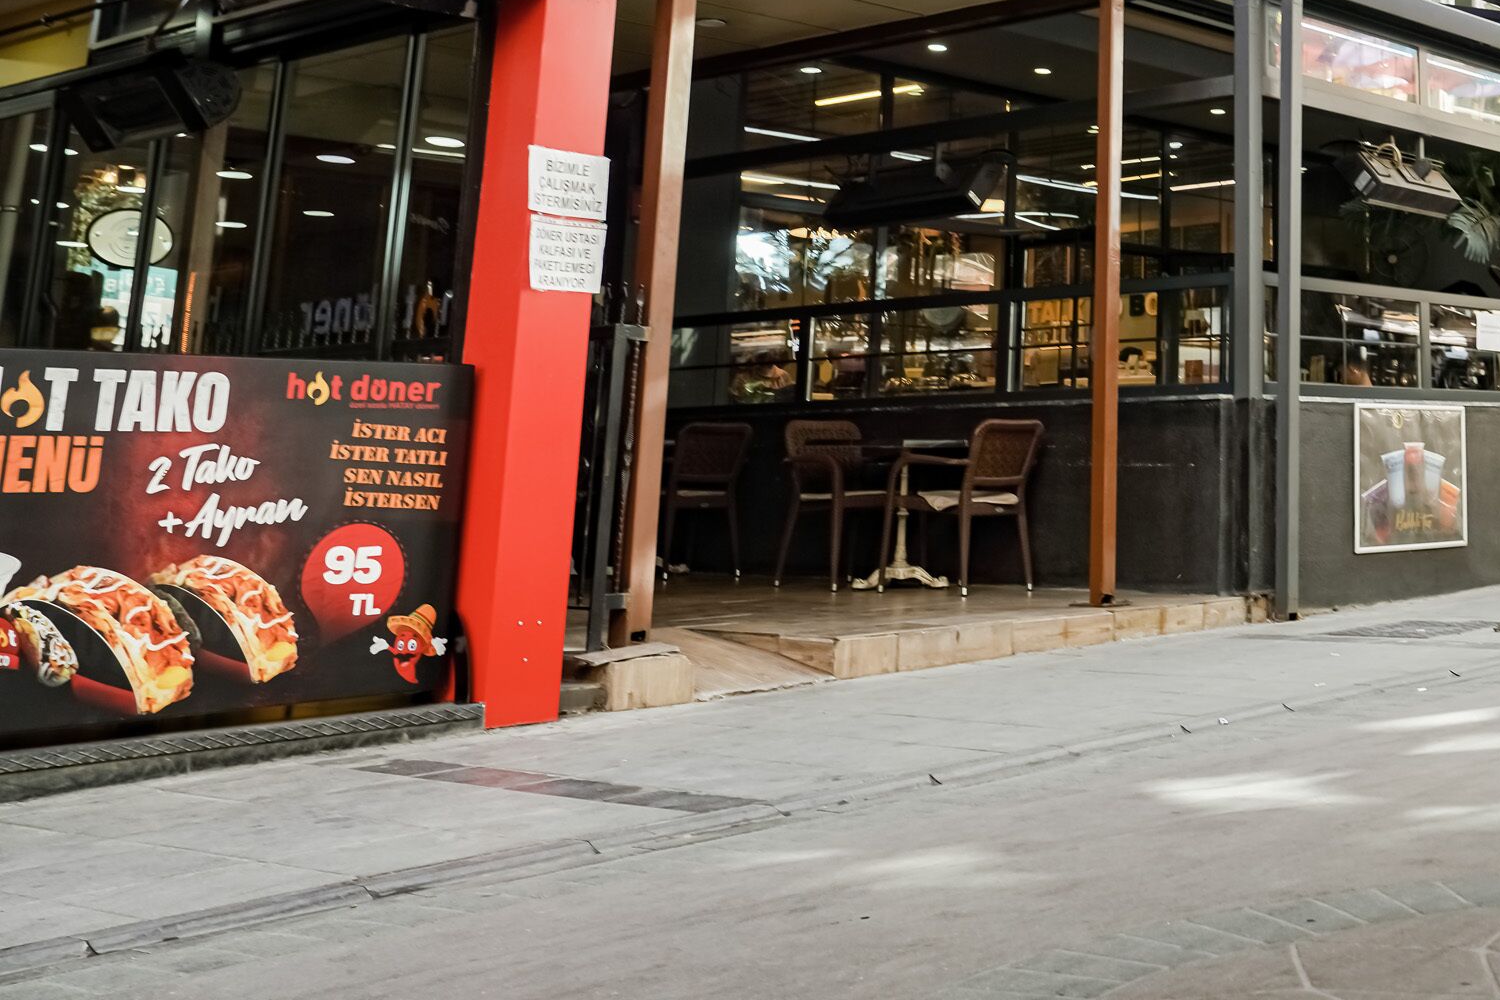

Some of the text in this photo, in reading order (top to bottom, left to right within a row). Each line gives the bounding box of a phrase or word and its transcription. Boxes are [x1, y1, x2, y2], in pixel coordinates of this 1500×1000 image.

[94, 369, 231, 432] TAKO
[287, 370, 442, 406] hot döner
[352, 418, 447, 444] İSTER ACI
[0, 436, 104, 494] ENÜ
[329, 439, 448, 466] İSTER TATLI
[145, 444, 261, 495] 2 Tako
[343, 467, 444, 489] SEN NASIL
[343, 486, 441, 511] İSTERSEN
[323, 546, 383, 585] 95
[349, 593, 381, 616] TL
